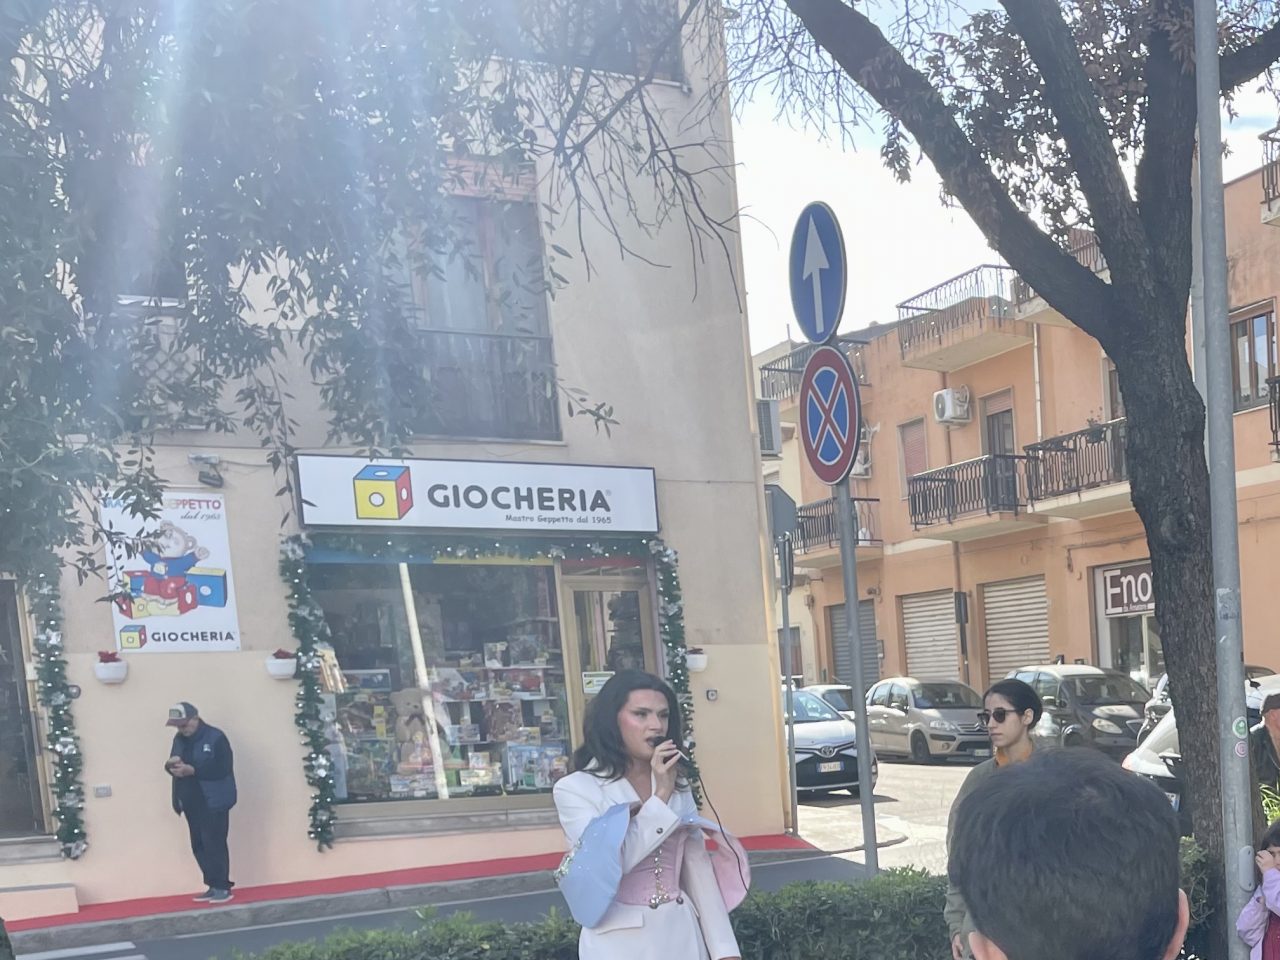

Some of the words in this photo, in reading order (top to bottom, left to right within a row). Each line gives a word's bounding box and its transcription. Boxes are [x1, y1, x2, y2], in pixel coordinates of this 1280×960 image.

[427, 484, 611, 512] GIOCHERIA
[505, 514, 534, 523] Mastro
[537, 515, 574, 524] Geppetto
[577, 515, 589, 524] dal
[592, 516, 612, 524] 1965
[1103, 570, 1153, 614] Eno
[151, 631, 235, 642] GIOCHERIA
